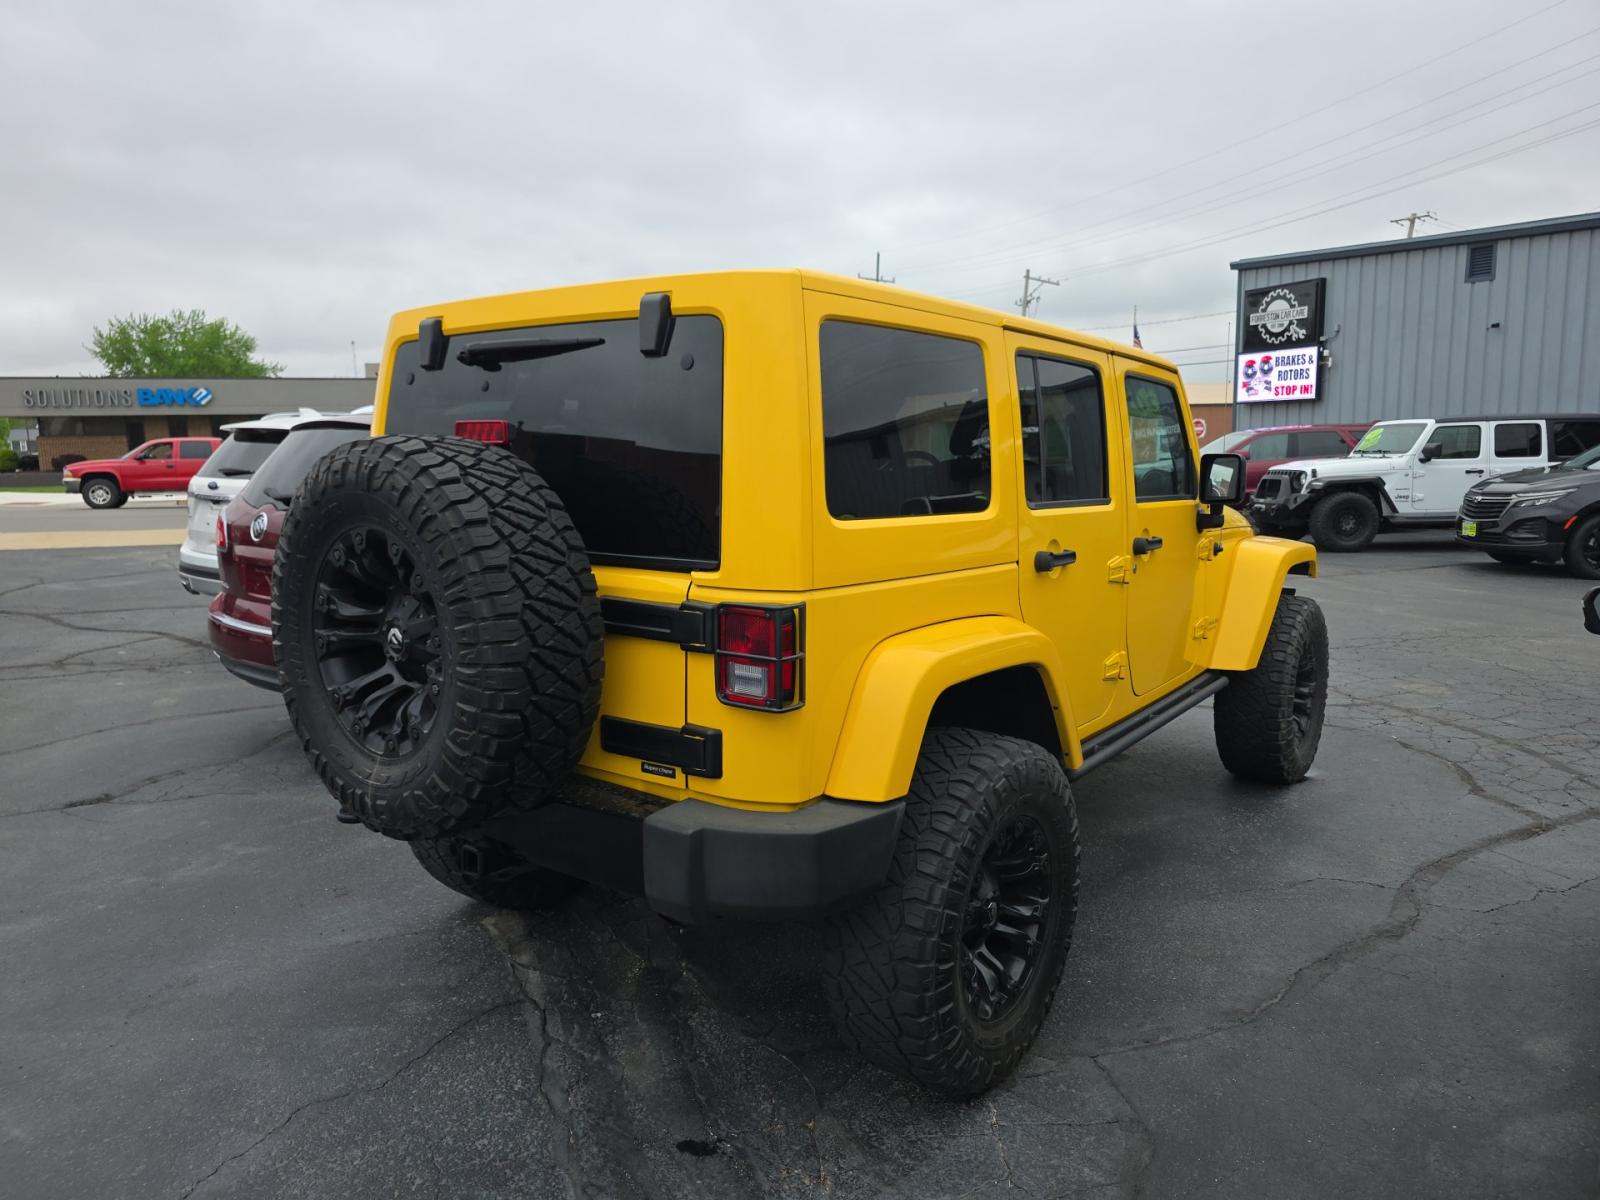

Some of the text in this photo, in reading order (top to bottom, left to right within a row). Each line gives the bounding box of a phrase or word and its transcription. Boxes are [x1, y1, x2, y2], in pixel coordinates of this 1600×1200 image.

[1275, 354, 1314, 367] BRAKES &
[1278, 368, 1310, 381] ROTORS
[1274, 384, 1313, 396] STOP IN!
[23, 387, 197, 408] SOLUTIONS BANK
